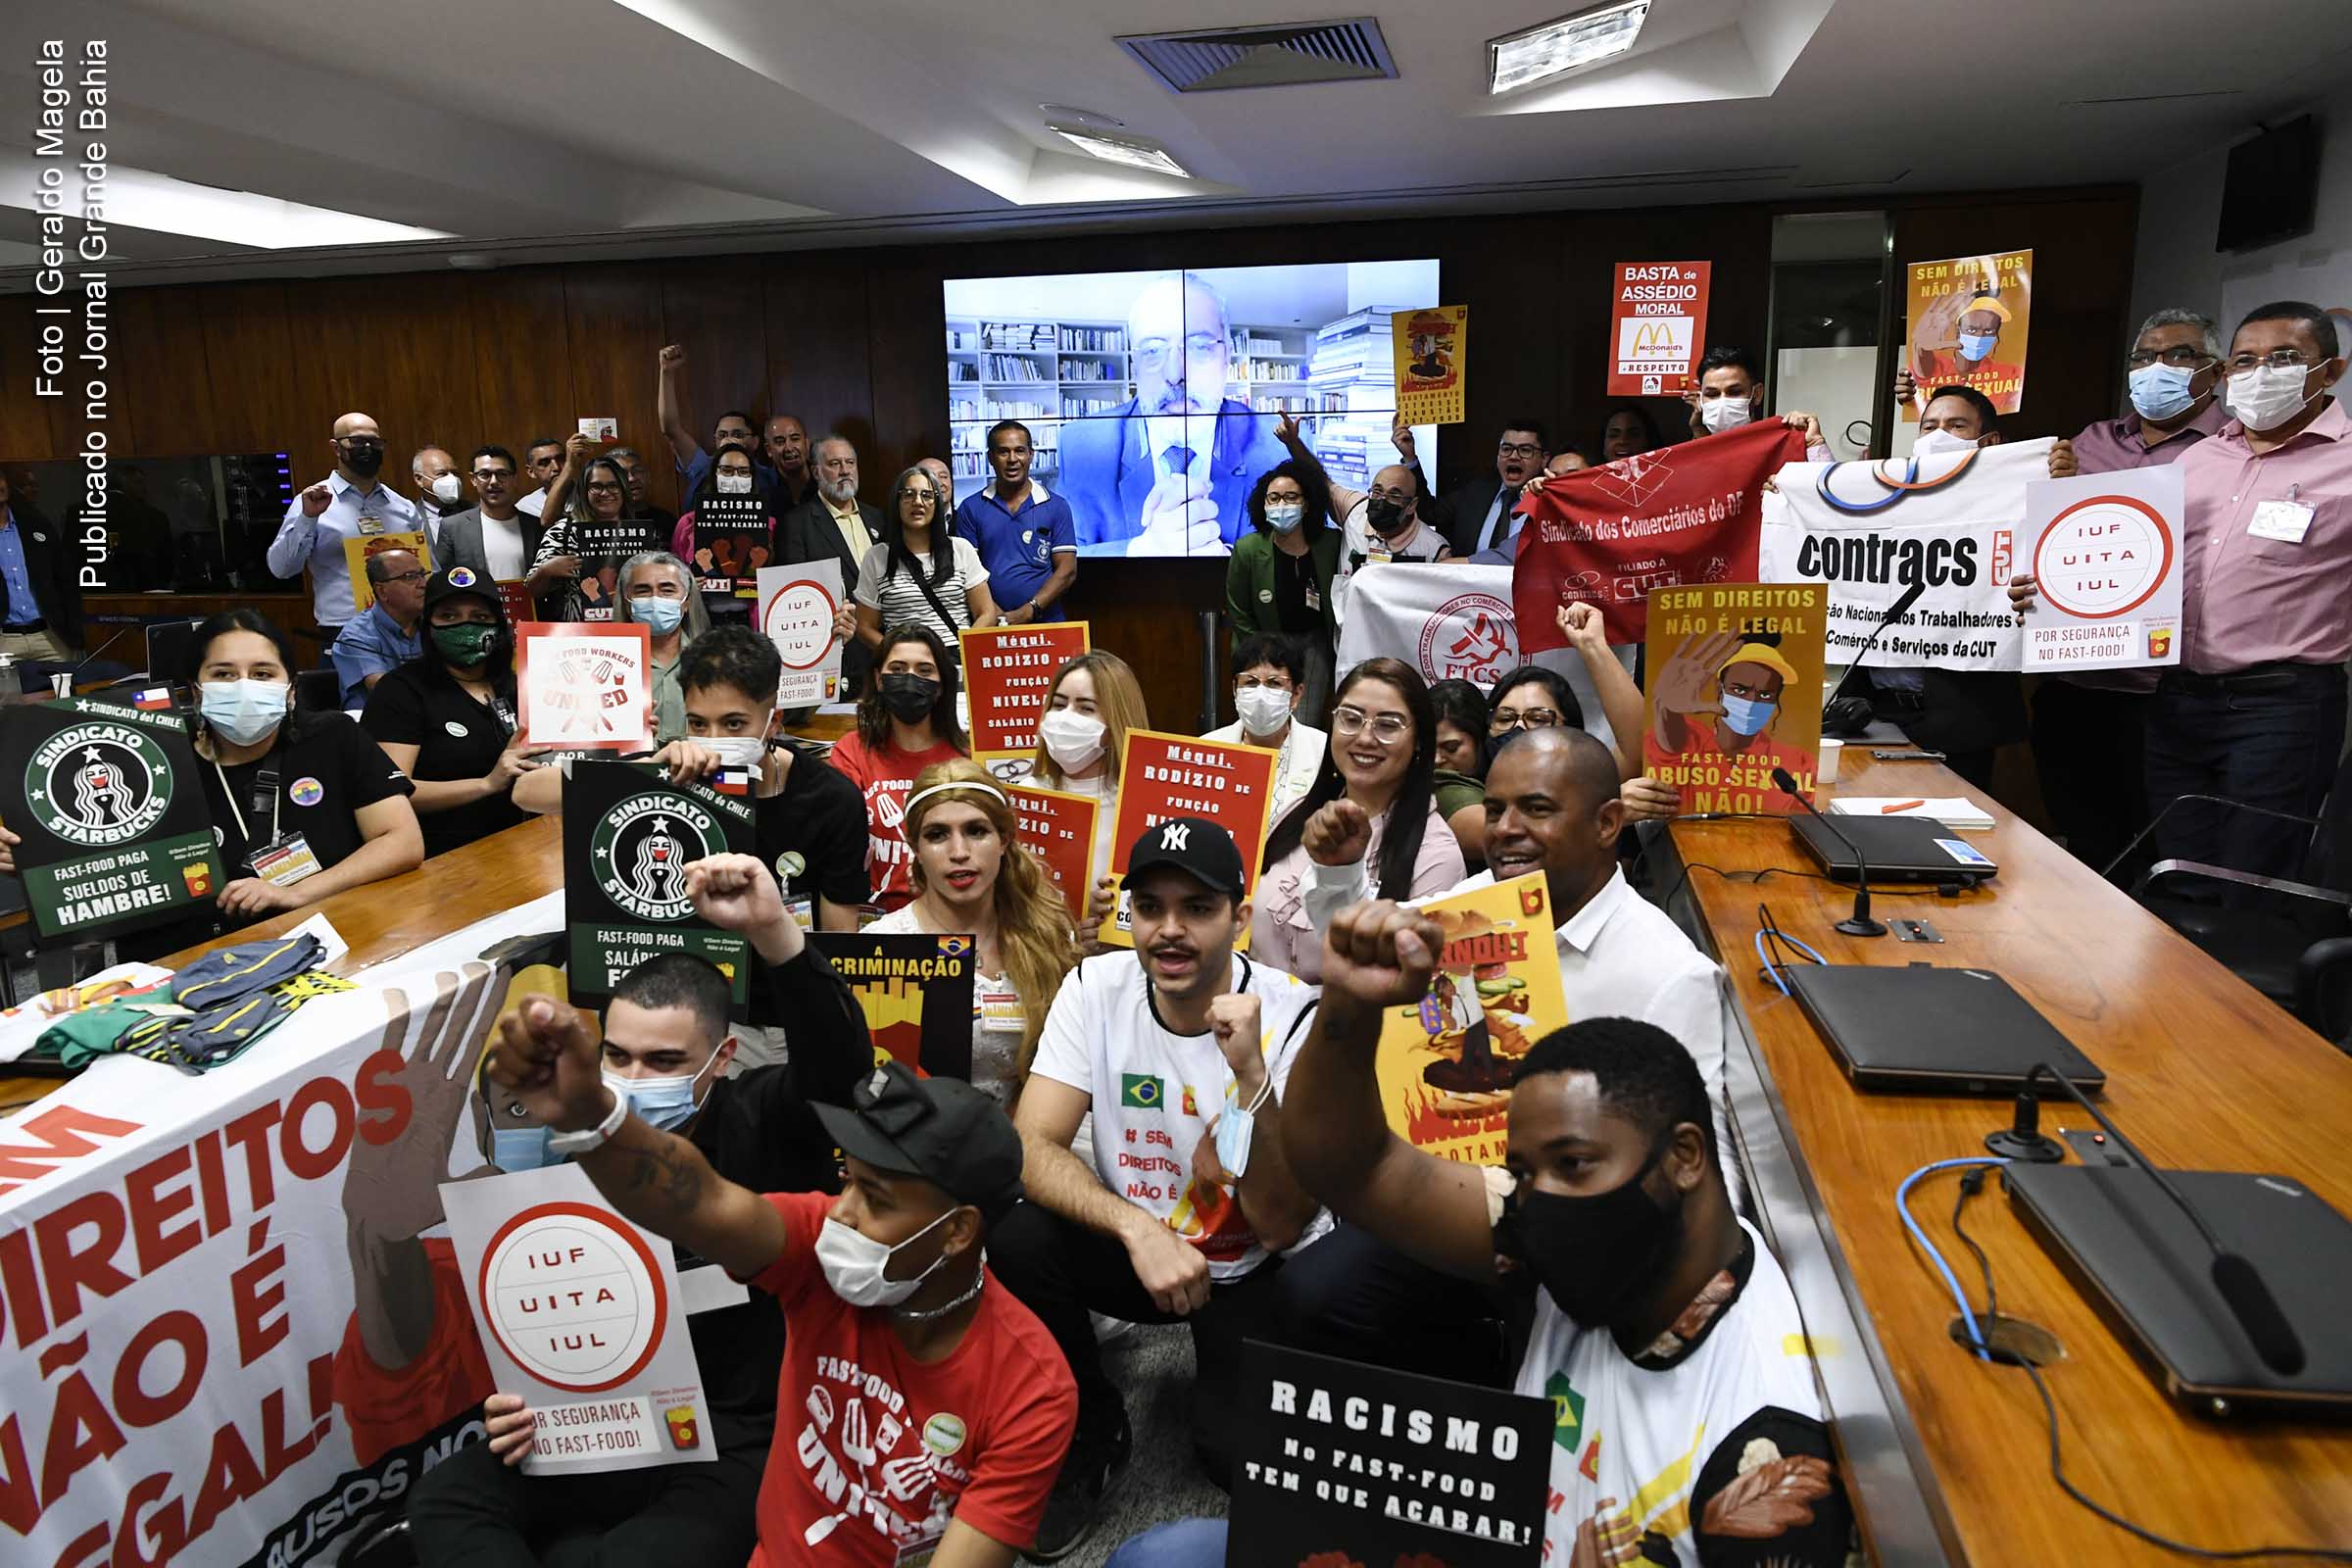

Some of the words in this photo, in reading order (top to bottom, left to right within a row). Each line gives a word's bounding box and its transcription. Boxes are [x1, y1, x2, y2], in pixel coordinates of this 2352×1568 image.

[1625, 267, 1680, 280] BASTA
[1684, 270, 1696, 280] de
[1916, 266, 1947, 280] SEM
[1954, 256, 2024, 276] DIRETOS
[1621, 281, 1697, 300] ASSÉDIO
[1921, 281, 1950, 298] NÃO
[1957, 281, 1965, 294] É
[1972, 275, 2018, 292] LEAL
[1635, 303, 1685, 316] MORAL
[1628, 364, 1685, 372] RESPEITO
[1930, 371, 1999, 385] FAST-FOOD
[703, 501, 762, 510] RACISMO
[1541, 519, 1592, 543] Sindicato
[1595, 518, 1618, 540] dos
[1622, 506, 1705, 538] Comerciários
[1709, 498, 1725, 521] do
[2079, 524, 2122, 537] IUF
[585, 528, 647, 538] RACISMO
[1796, 533, 1978, 587] contracs
[2063, 550, 2134, 565] UITA
[2078, 579, 2120, 591] IUL
[788, 600, 811, 611] IUF
[1660, 591, 1703, 610] SEM
[1714, 590, 1815, 608] DIREITOS
[781, 619, 819, 631] UITA
[1666, 614, 1707, 635] NÃO
[1718, 613, 1729, 634] É
[1740, 617, 1807, 634] LEGAL
[1845, 604, 1887, 623] Naciona
[1920, 610, 2012, 628] Trabalhadores
[997, 633, 1053, 649] Méqui.
[1826, 629, 1879, 651] Comércio
[1882, 638, 1888, 650] e
[1892, 637, 1949, 659] Serviços
[1970, 641, 1997, 658] CUT
[2034, 629, 2057, 642] POR
[2062, 624, 2131, 644] SEGURANÇA
[789, 640, 812, 650] IUL
[2038, 648, 2054, 660] NO
[2059, 644, 2125, 661] FAST-FOOD!
[590, 647, 636, 669] WORKERS
[982, 653, 1050, 668] RODÍZIO
[782, 674, 817, 687] SEGURANÇA
[1005, 675, 1050, 688] FUNÇÃO
[780, 688, 815, 700] FAST-FOOD!
[993, 695, 1046, 708] NIVEL
[90, 702, 137, 721] SINDICATO
[139, 711, 154, 723] del
[156, 714, 182, 729] CHILE
[988, 717, 1035, 728] SALÁRIO
[36, 725, 143, 768] SINDICATO
[1004, 735, 1038, 747] BAIX
[1167, 745, 1235, 769] Méqui.
[1681, 753, 1782, 765] FAST-FOOD
[882, 780, 913, 790] FOOD
[1145, 765, 1225, 790] RODÍZIO
[1235, 784, 1250, 794] DE
[1646, 767, 1720, 786] ABUSO
[1731, 768, 1816, 793] SEXAL
[726, 800, 752, 819] CHILE
[1009, 794, 1058, 816] équi.
[1166, 796, 1219, 813] FUNÇÃO
[1695, 787, 1764, 815] NÃO!
[48, 795, 166, 844] STARBUCKS
[608, 795, 710, 831] SINDICATO
[1059, 829, 1074, 840] DE
[54, 855, 116, 881] FAST-FOOD
[119, 850, 149, 868] PAGA
[63, 874, 128, 902] SUELDOS
[133, 869, 151, 885] DE
[56, 883, 172, 925] HAMBRE!
[604, 878, 695, 919] STARBUC
[597, 930, 654, 946] FAST-FOOD
[657, 932, 684, 947] PAGA
[605, 950, 661, 966] SALÁR
[830, 956, 961, 981] CRIMINAÇÃO
[1146, 1130, 1173, 1149] SEM
[1118, 1152, 1182, 1176] DIREITOS
[0, 1049, 414, 1349] IREITOS
[1127, 1181, 1161, 1200] NÃO
[1168, 1183, 1178, 1200] É
[528, 1248, 585, 1270] IUF
[230, 1216, 291, 1369] É
[519, 1287, 615, 1313] UITA
[550, 1334, 606, 1352] IUL
[816, 1355, 859, 1387] FAST
[531, 1409, 546, 1429] OR
[554, 1401, 641, 1428] SEGURANÇA
[1271, 1380, 1519, 1461] RACISMO
[533, 1437, 552, 1456] NO
[558, 1430, 643, 1455] FAST-FOOD!
[52, 1351, 334, 1568] GAL!
[1284, 1438, 1315, 1461] No
[1333, 1449, 1496, 1501] FAST-FOOD
[1246, 1461, 1300, 1492] TEM
[1316, 1480, 1368, 1509] QUE
[1385, 1494, 1532, 1545] ACABAR!
